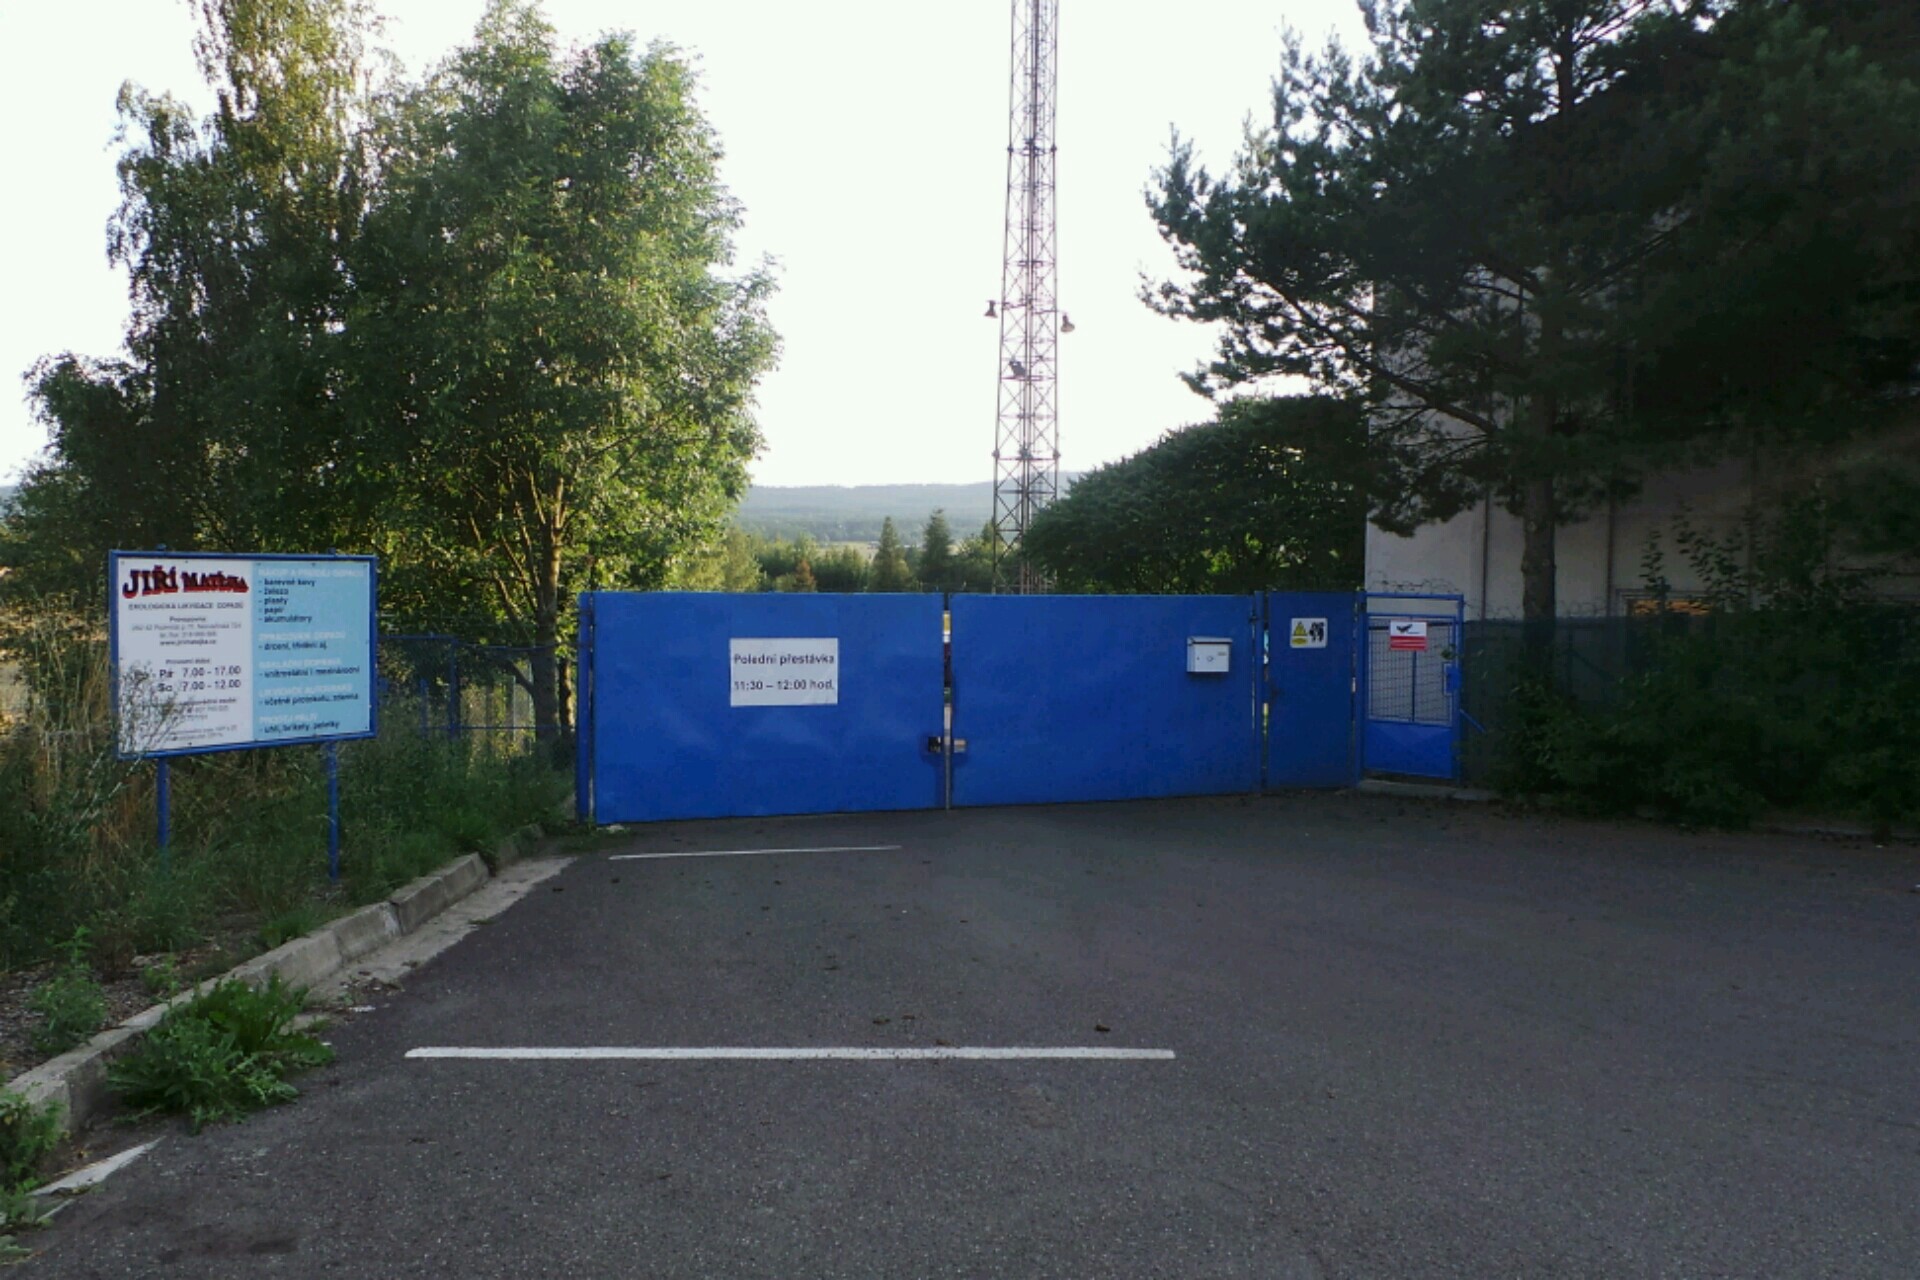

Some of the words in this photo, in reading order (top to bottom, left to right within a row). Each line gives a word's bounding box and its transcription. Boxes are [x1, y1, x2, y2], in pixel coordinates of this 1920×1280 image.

[123, 564, 178, 599] JIŘÍ
[734, 654, 777, 664] Polední
[780, 654, 834, 666] přestávka
[182, 667, 205, 678] 7.00
[214, 665, 241, 676] 17.00
[214, 679, 241, 690] 12.00
[734, 680, 763, 690] 11:30
[778, 679, 806, 690] 12:00
[810, 679, 834, 690] hod.
